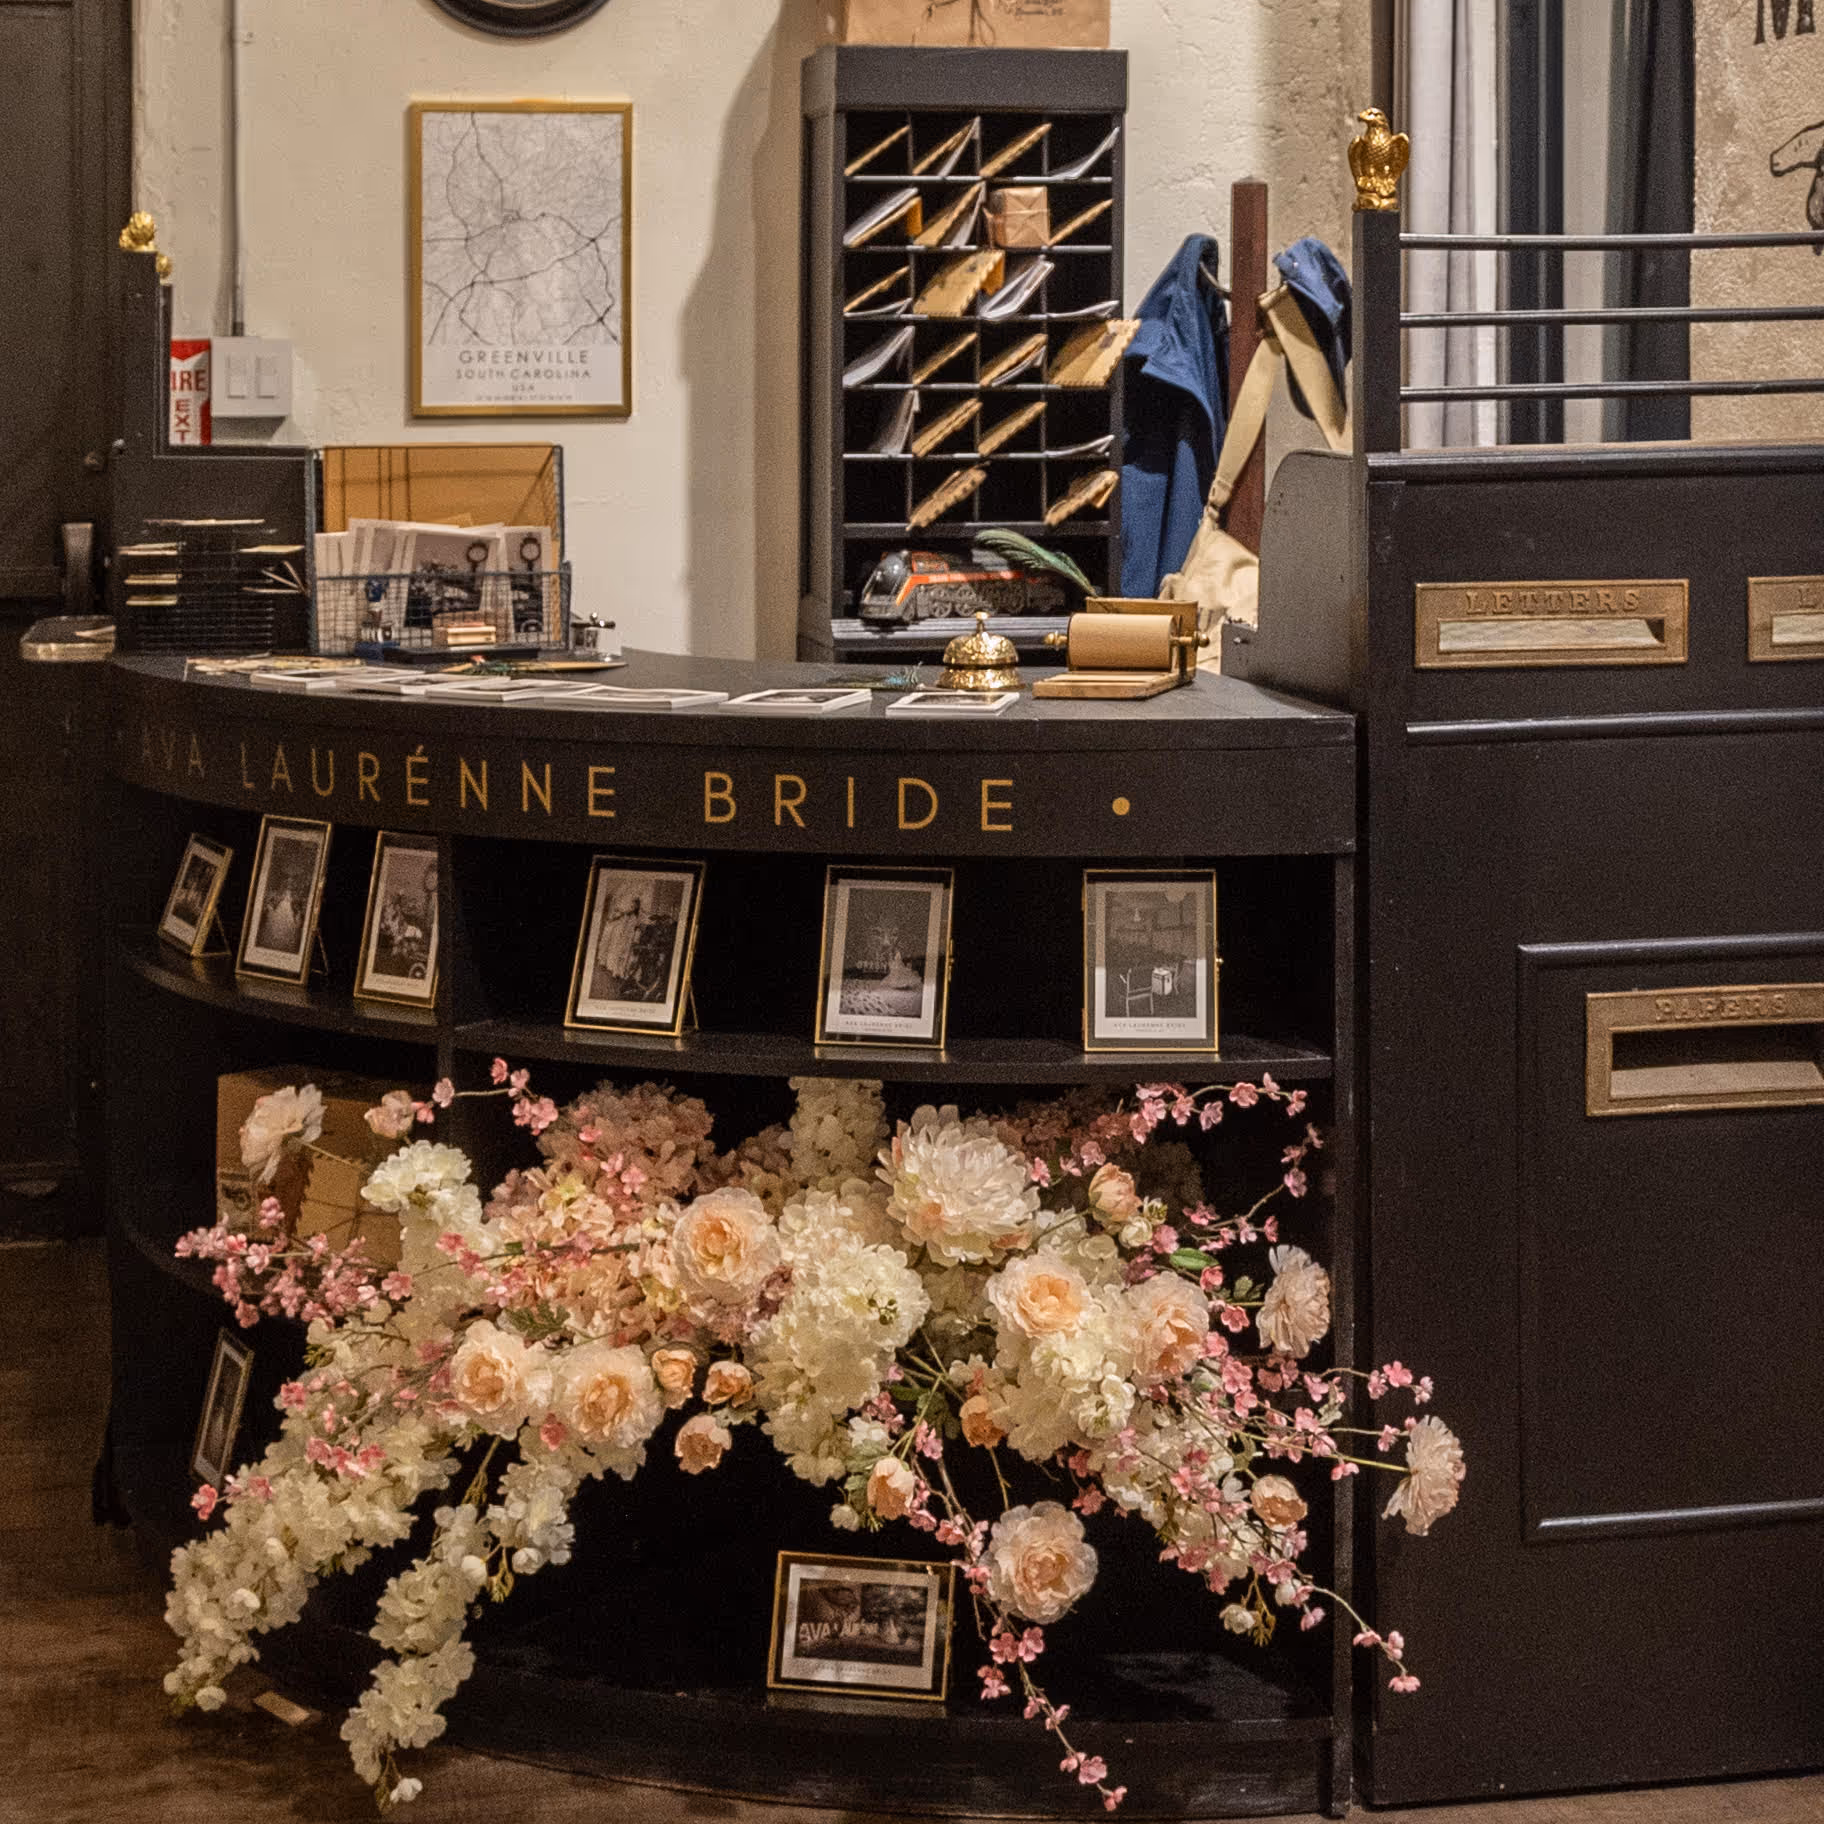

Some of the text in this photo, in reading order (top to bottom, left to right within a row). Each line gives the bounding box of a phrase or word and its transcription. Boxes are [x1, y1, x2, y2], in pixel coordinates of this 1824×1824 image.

[458, 349, 589, 365] GREENVILLE
[170, 369, 207, 392] IRE
[455, 368, 592, 380] SOUTH CAROLINA
[1465, 587, 1642, 616] LETTERS
[240, 742, 616, 818] LAURÉNNE
[703, 771, 1014, 832] BRIDE
[1654, 993, 1787, 1022] PAPERS
